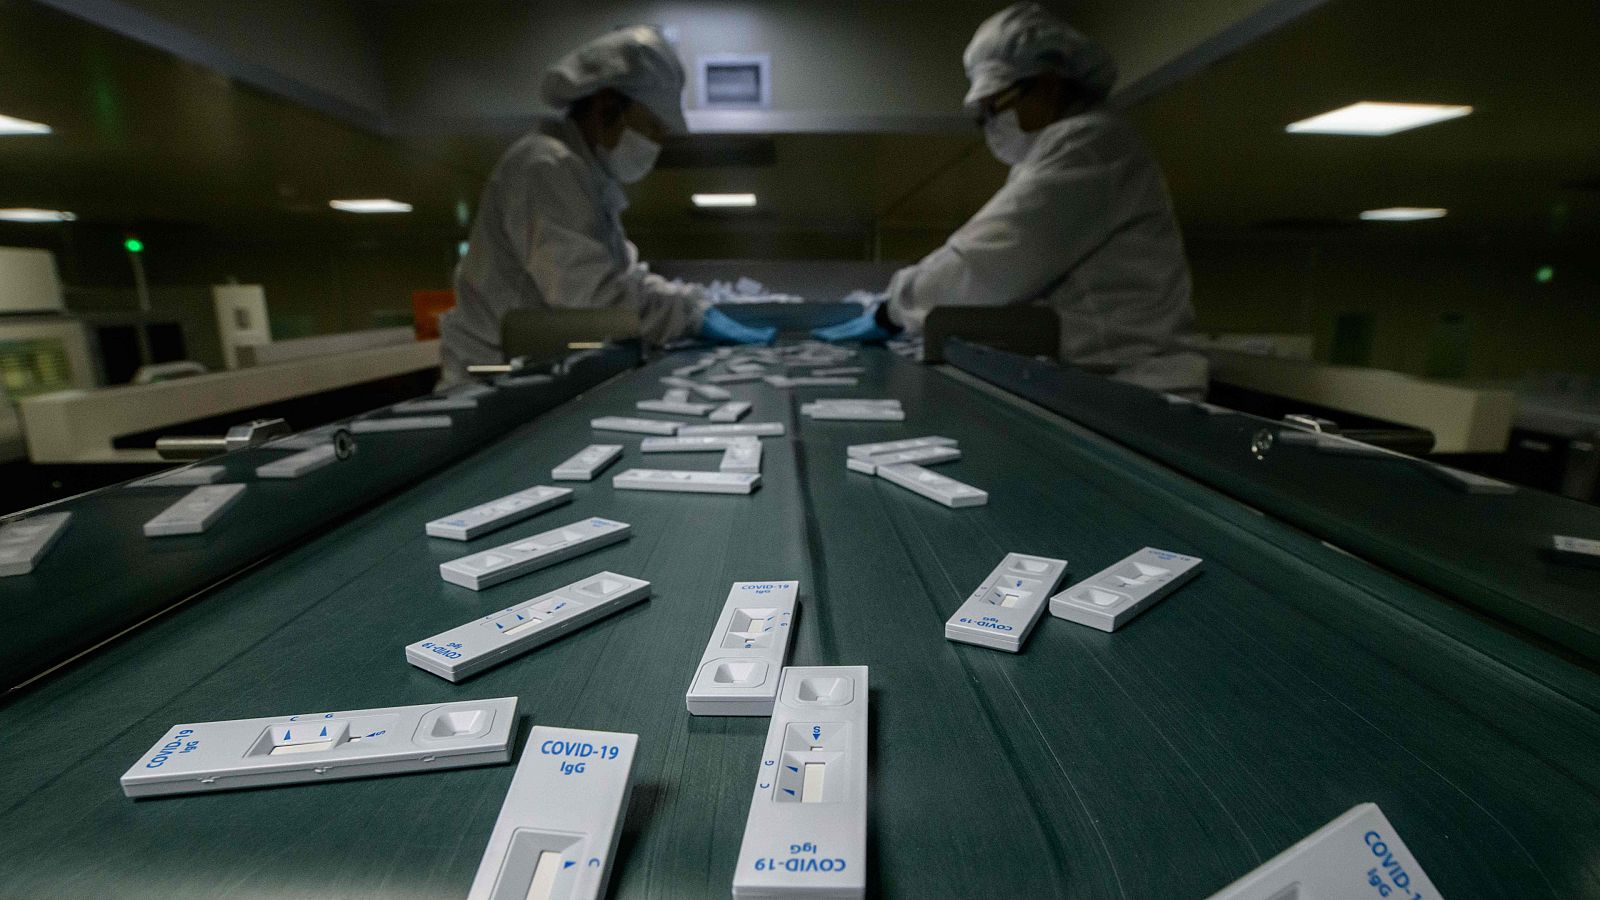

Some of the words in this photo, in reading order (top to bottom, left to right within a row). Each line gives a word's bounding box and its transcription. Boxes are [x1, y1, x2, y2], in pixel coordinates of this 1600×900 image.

[960, 617, 1013, 631] COVID-19
[422, 642, 462, 660] COVID-19
[146, 729, 194, 769] COVID-19
[179, 740, 200, 754] IgG
[541, 740, 619, 760] COVID-19
[560, 761, 586, 775] IgG
[789, 842, 817, 854] IgG
[588, 858, 600, 868] C
[754, 858, 846, 872] COVID-19
[1367, 867, 1393, 898] IgG
